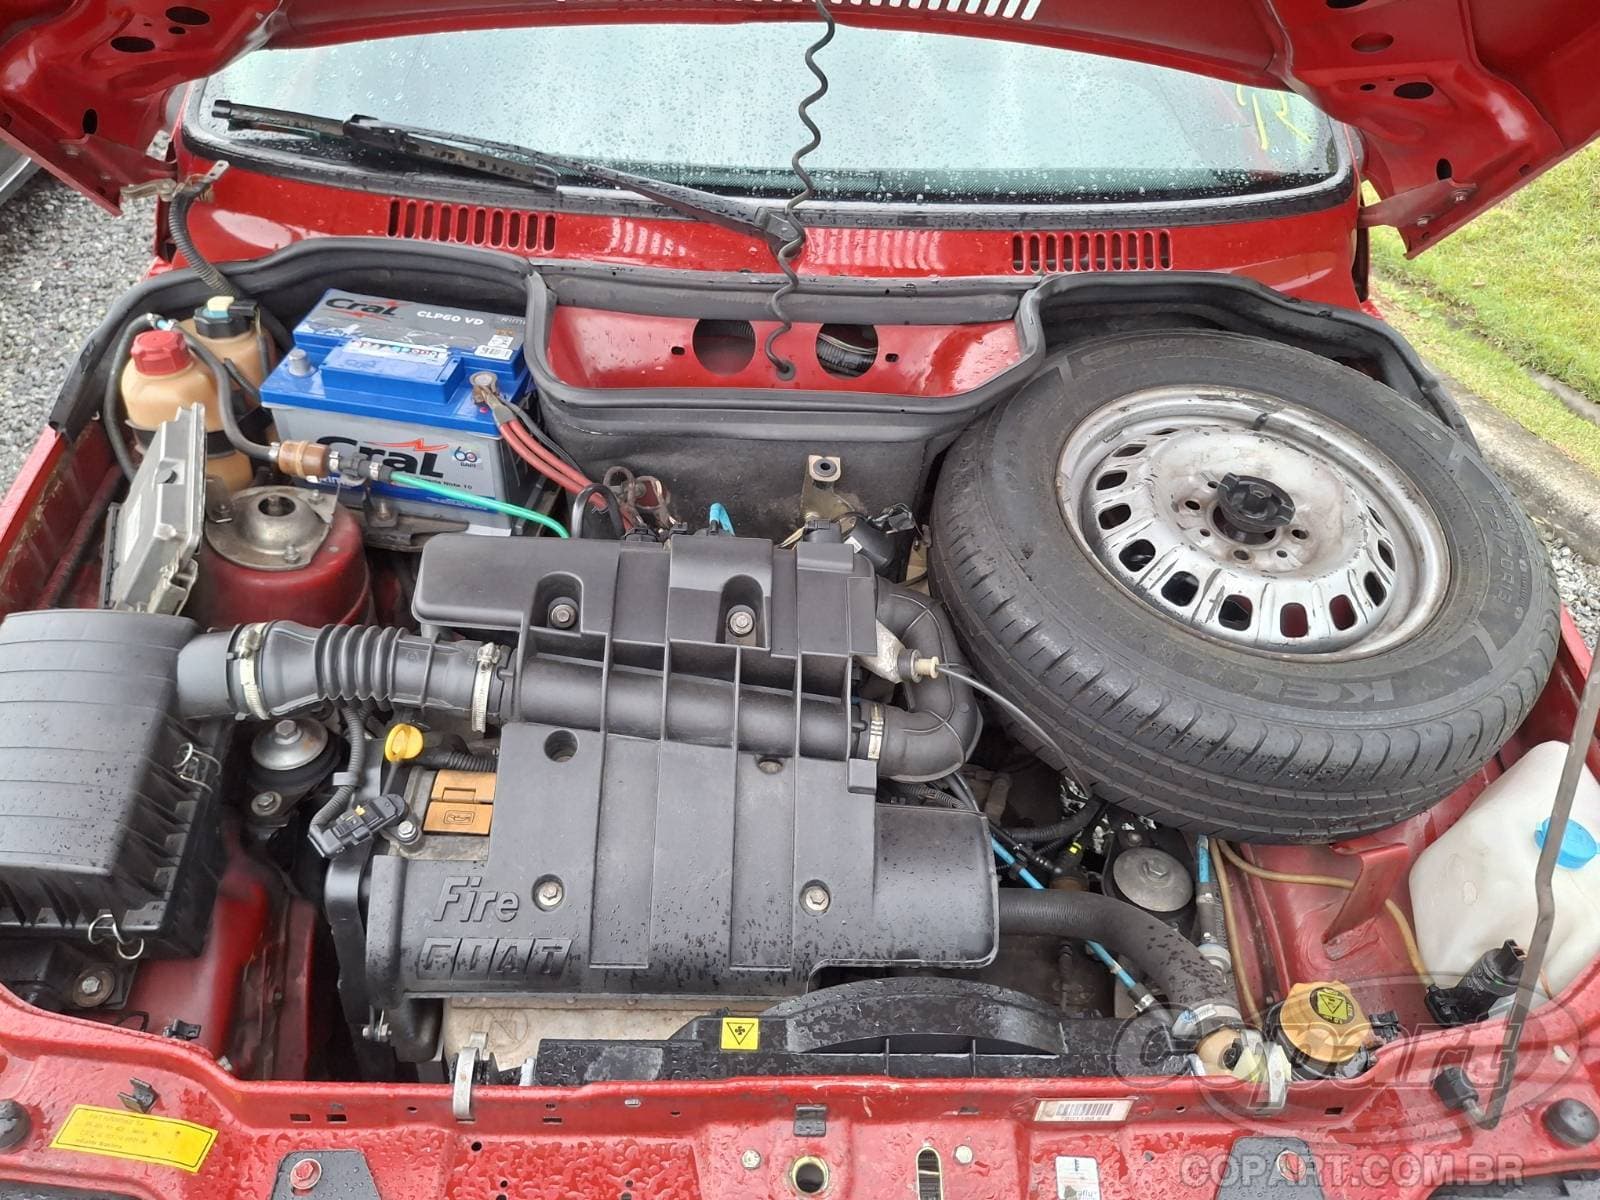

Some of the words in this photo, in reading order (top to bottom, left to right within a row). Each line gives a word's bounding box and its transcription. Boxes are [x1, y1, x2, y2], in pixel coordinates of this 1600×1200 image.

[416, 310, 462, 323] CLP60
[463, 317, 485, 326] VD
[433, 875, 520, 923] Fire
[420, 940, 567, 977] FIAT
